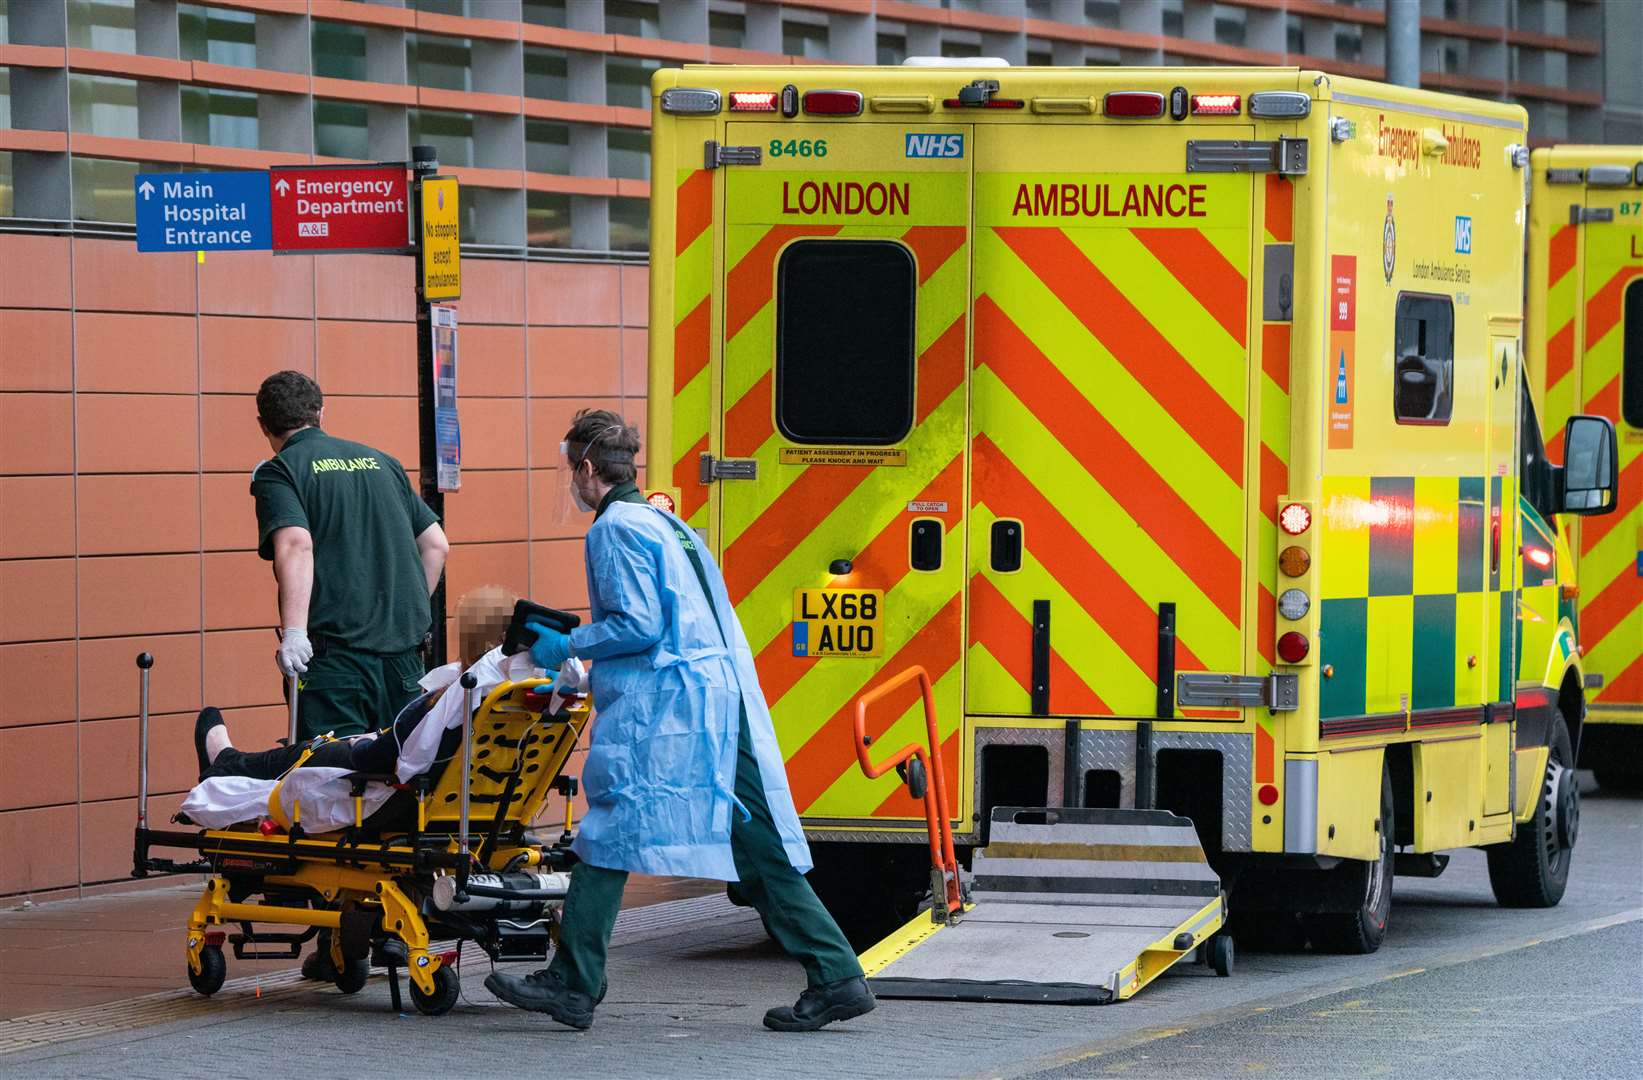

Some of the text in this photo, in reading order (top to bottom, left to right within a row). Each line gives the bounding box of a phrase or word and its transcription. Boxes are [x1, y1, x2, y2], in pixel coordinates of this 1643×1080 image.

[769, 139, 828, 157] 8466
[906, 135, 962, 156] NHS
[1379, 114, 1419, 169] Emergency
[163, 181, 213, 198] Main
[296, 179, 393, 197] Emergency
[782, 181, 910, 215] LONDON
[297, 199, 404, 218] Department
[1012, 183, 1207, 217] AMBULANCE
[164, 203, 246, 225] Hospital
[165, 228, 252, 245] Entrance
[301, 223, 327, 235] A&E
[426, 219, 457, 240] No stopping
[1455, 217, 1471, 252] NHS
[433, 247, 451, 265] except
[428, 271, 458, 288] ambulances
[1413, 259, 1471, 283] London Ambulance Service
[1338, 301, 1348, 320] 999
[312, 457, 380, 473] AMBULANCE
[802, 592, 877, 620] LX68
[818, 625, 873, 652] AUO
